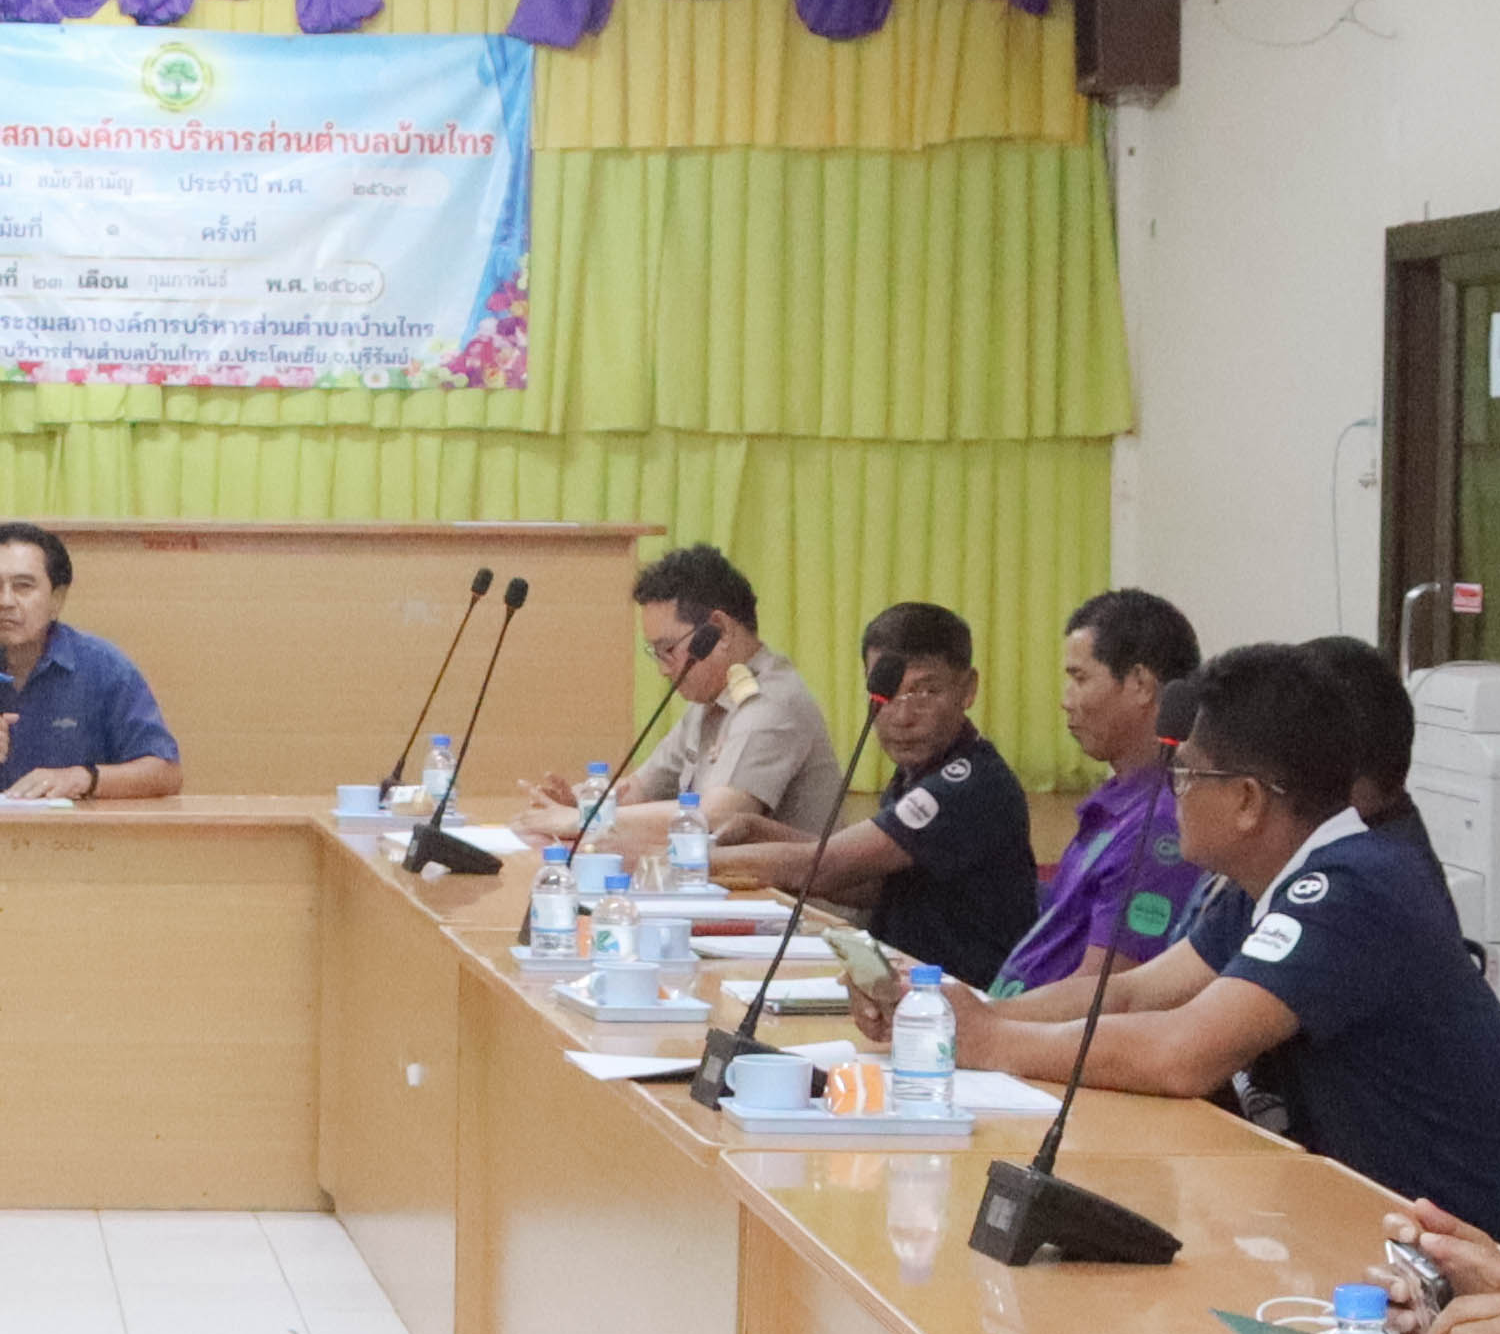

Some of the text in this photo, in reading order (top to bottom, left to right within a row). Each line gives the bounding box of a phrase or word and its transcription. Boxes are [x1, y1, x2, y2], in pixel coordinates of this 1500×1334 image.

[177, 171, 259, 195] ประจำปี
[266, 177, 309, 195] พ.ศ.
[200, 214, 258, 244] ครั้งที่
[77, 269, 129, 290] เดือน
[266, 277, 307, 294] พ.ศ.
